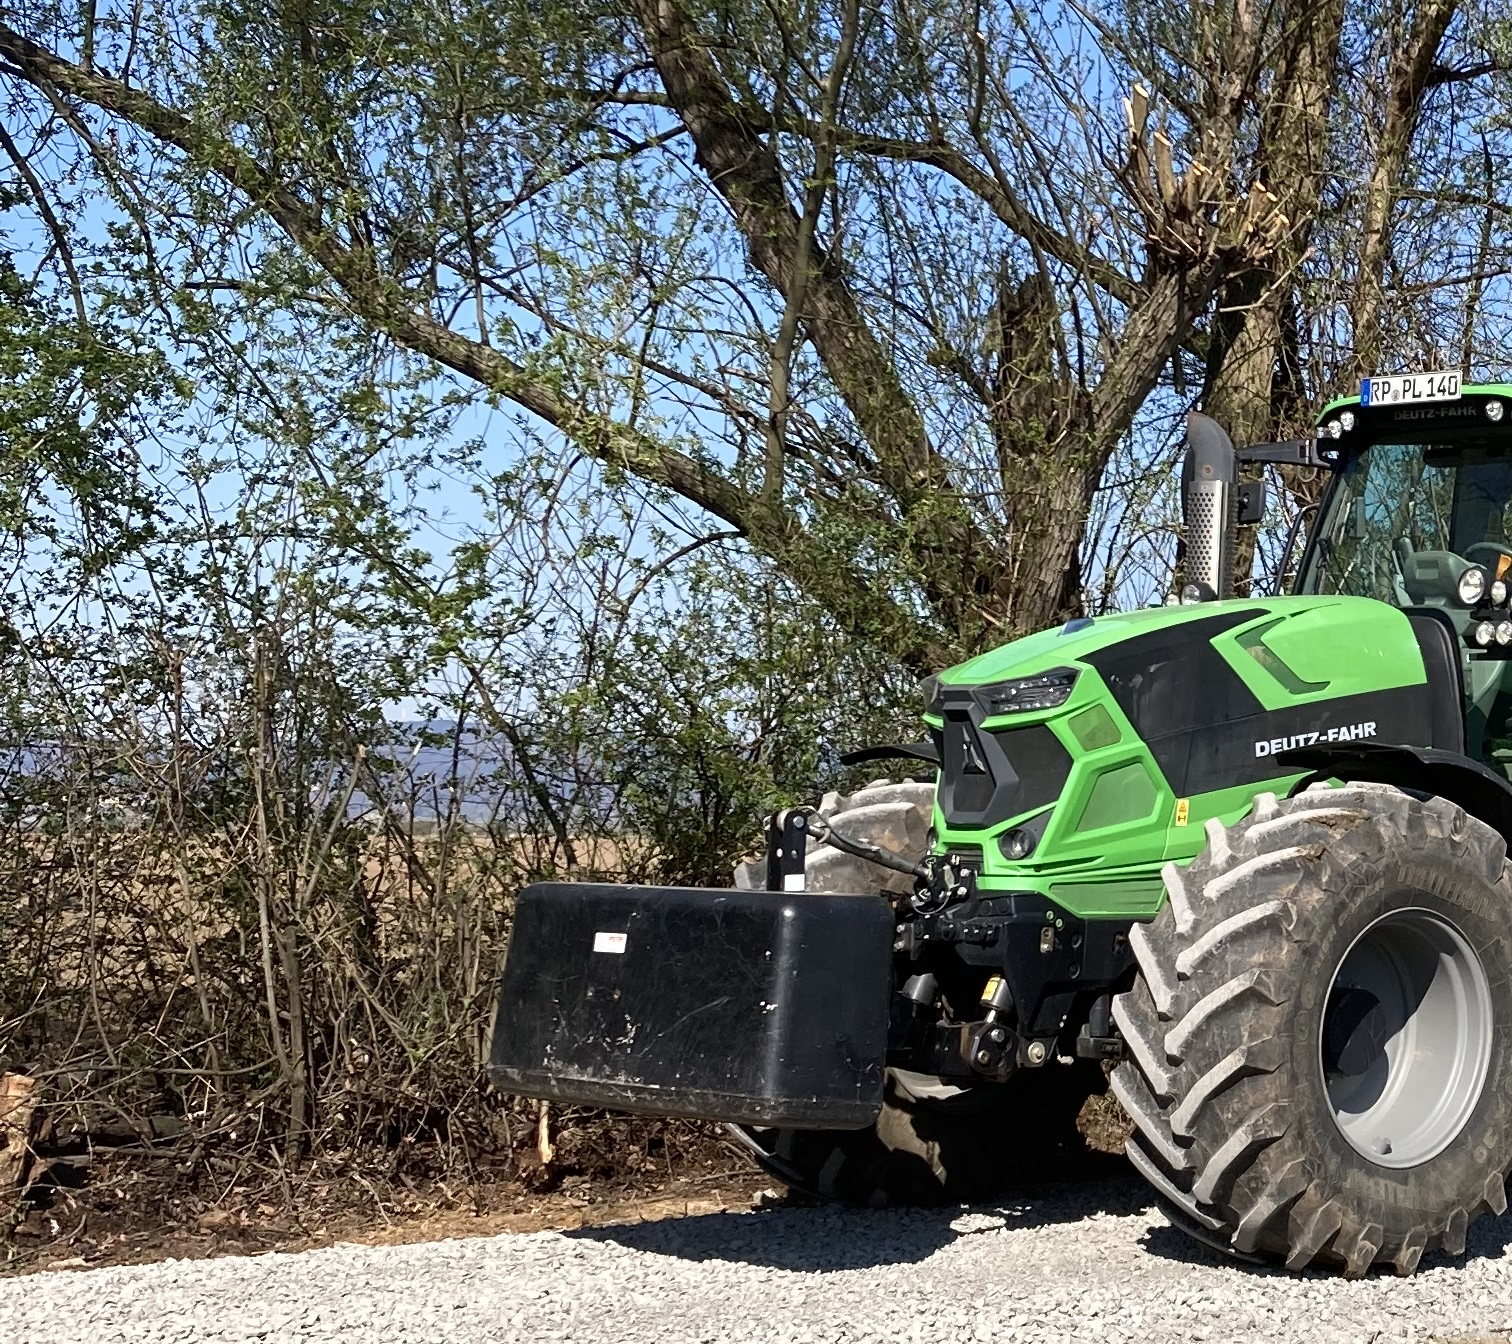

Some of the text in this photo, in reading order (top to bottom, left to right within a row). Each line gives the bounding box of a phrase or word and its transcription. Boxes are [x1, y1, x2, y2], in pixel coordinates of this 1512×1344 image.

[1370, 375, 1458, 402] RP PL 140
[1393, 406, 1477, 420] DEUTZ-FAHR
[1255, 721, 1377, 758] DEUTZ-FAHR
